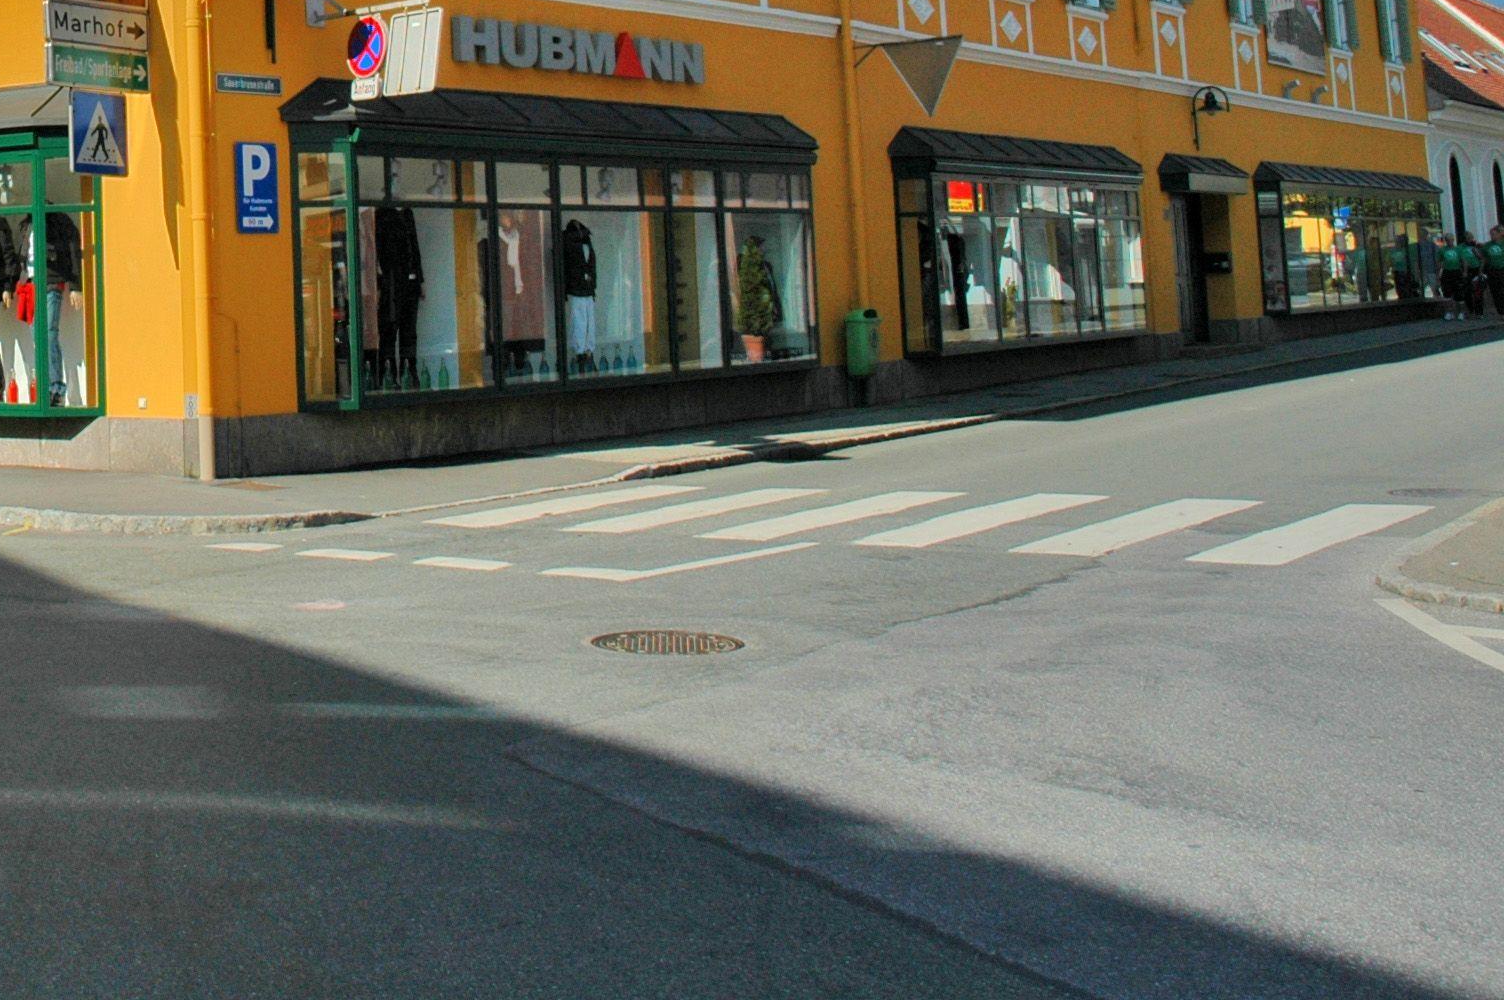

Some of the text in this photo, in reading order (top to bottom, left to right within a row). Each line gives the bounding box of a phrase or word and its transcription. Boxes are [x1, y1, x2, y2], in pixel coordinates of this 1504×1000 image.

[54, 10, 124, 38] Marhof
[451, 15, 704, 84] HUBMANN
[242, 144, 271, 197] P
